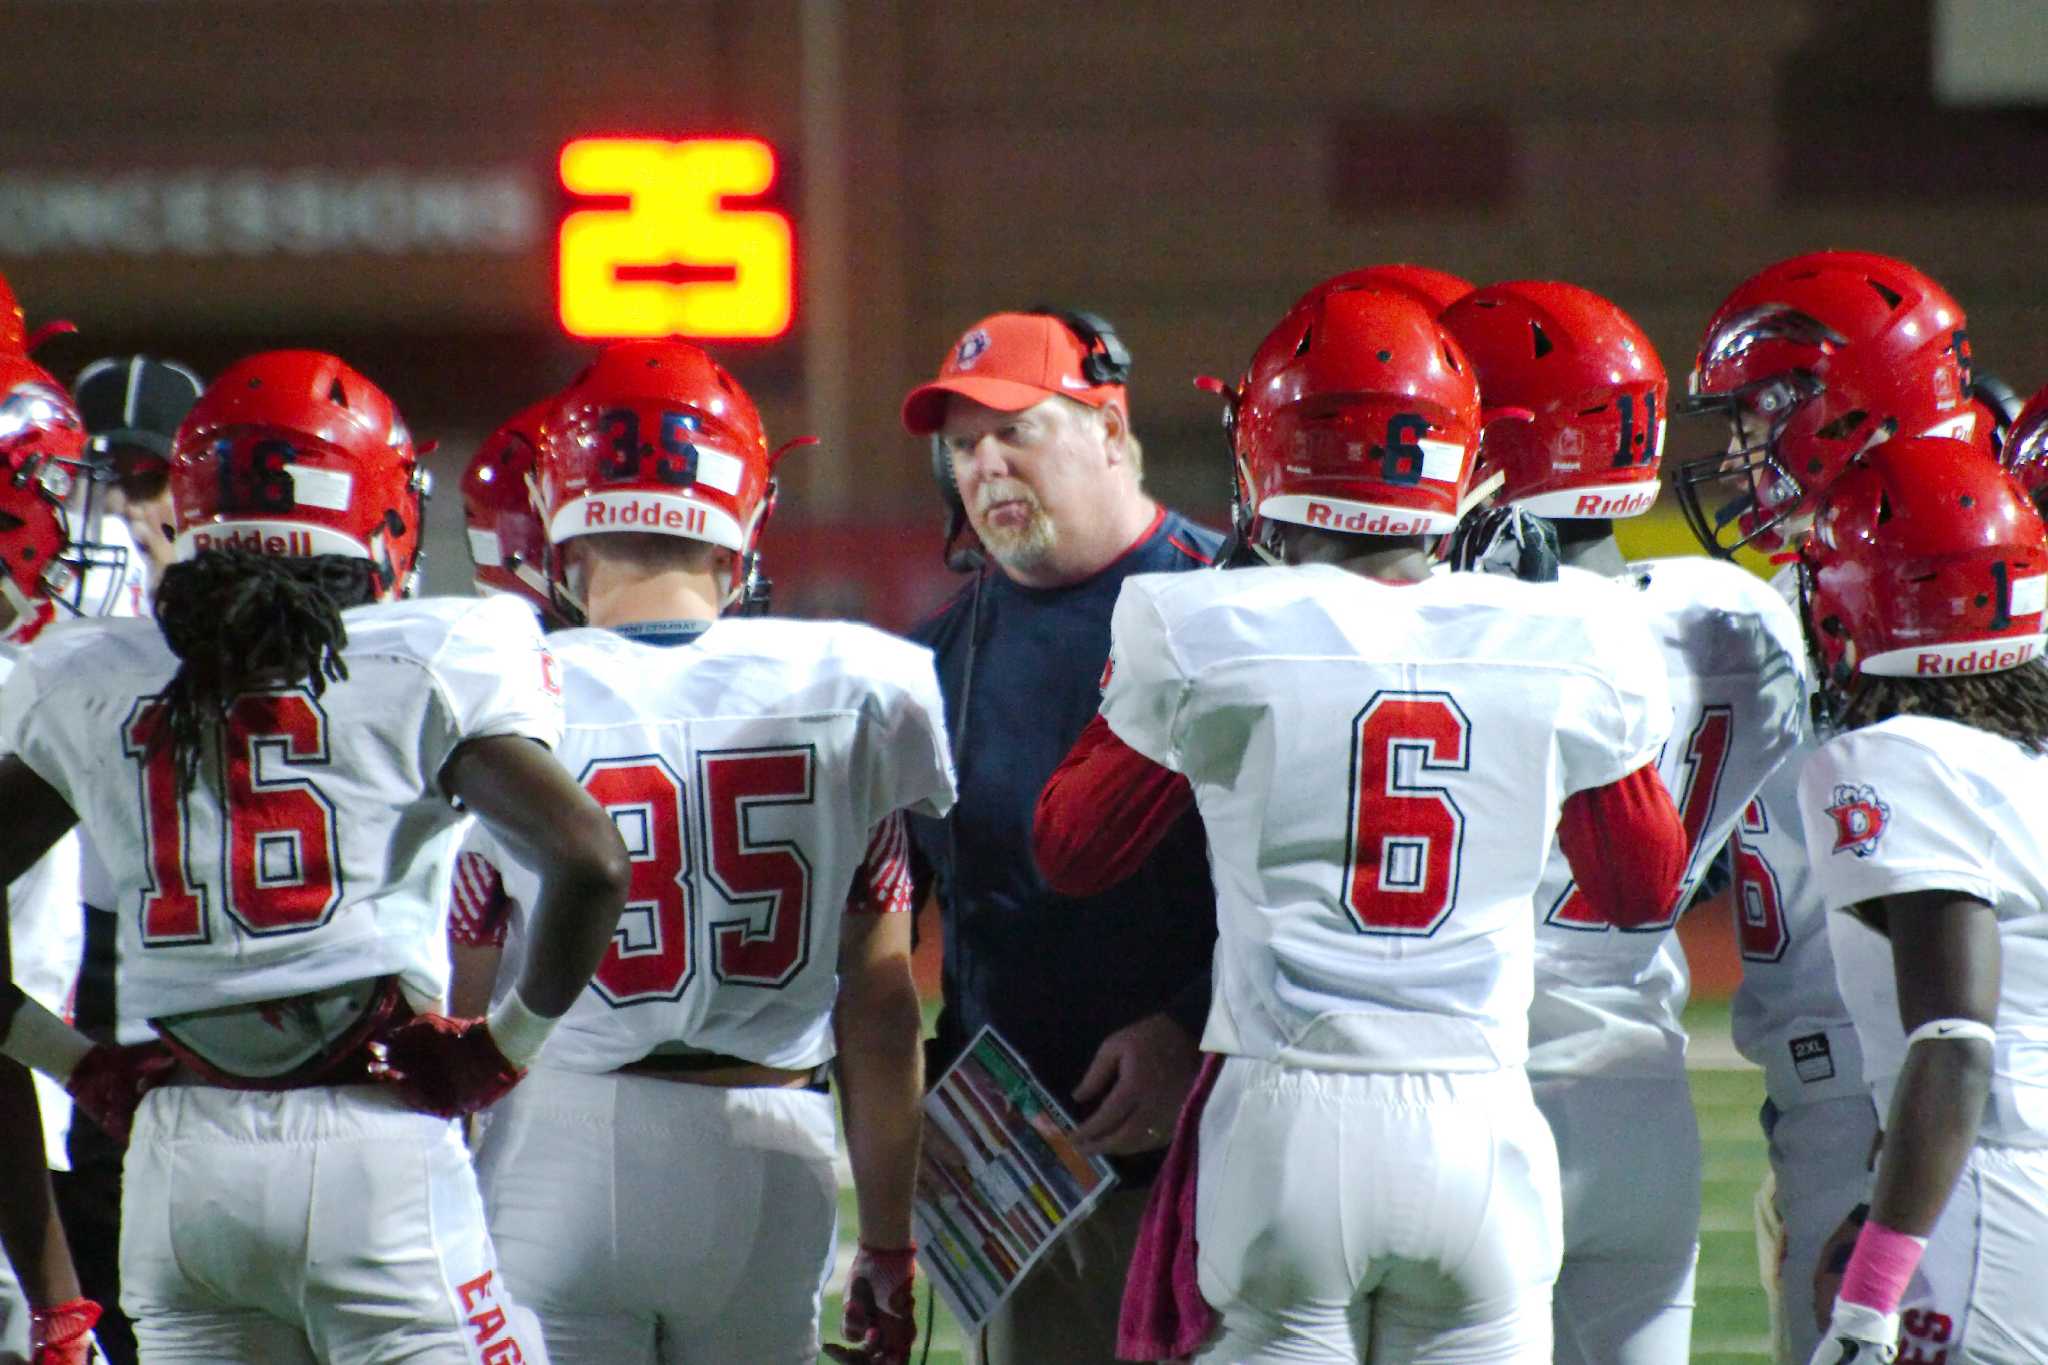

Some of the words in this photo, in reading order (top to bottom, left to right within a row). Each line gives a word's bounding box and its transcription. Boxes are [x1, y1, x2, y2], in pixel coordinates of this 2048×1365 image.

[601, 408, 700, 486] 35
[1382, 413, 1428, 485] 6
[1611, 391, 1656, 467] 11
[214, 438, 296, 514] 16
[585, 501, 707, 533] Riddell
[1306, 502, 1432, 536] Riddell
[1989, 560, 2011, 630] 1
[1916, 644, 2033, 675] Riddell
[121, 685, 344, 949] 16
[1340, 690, 1472, 938] 6
[577, 743, 816, 1009] 35
